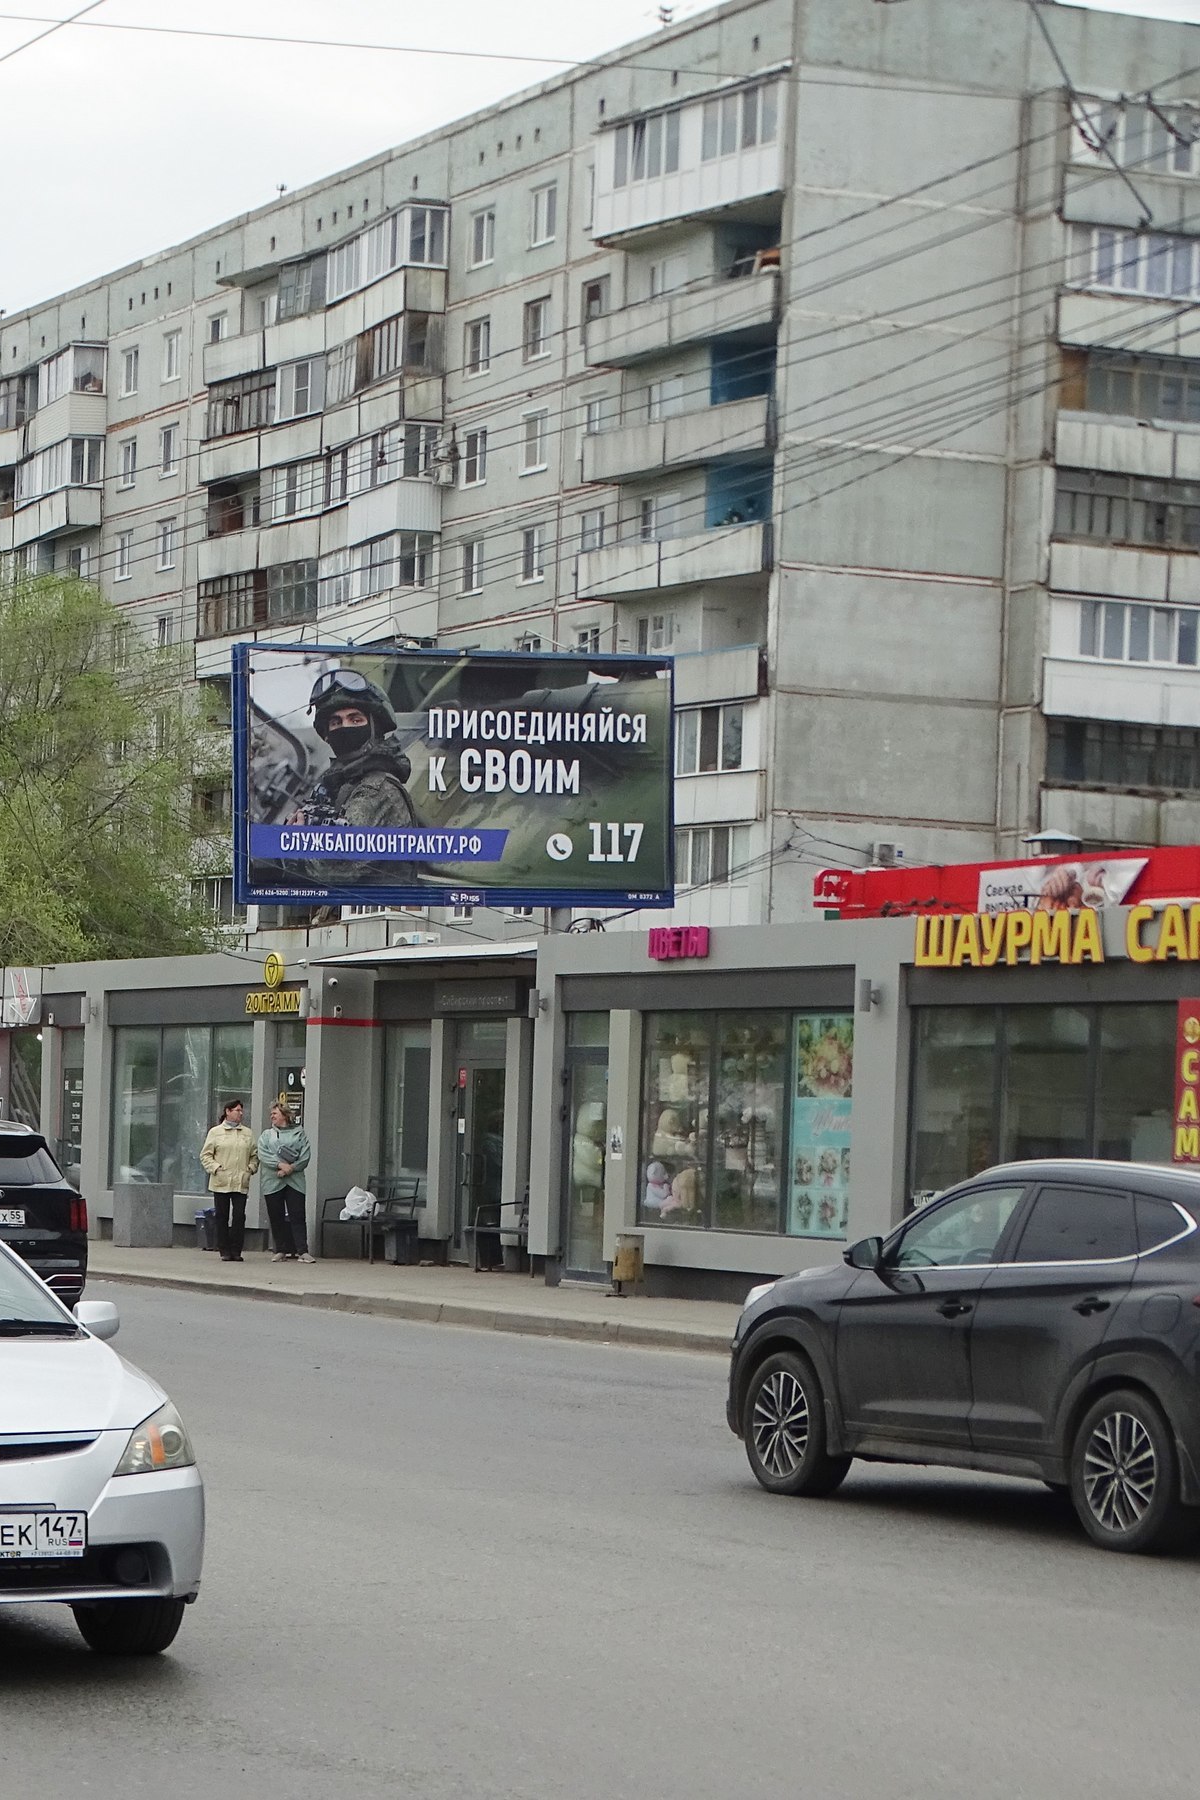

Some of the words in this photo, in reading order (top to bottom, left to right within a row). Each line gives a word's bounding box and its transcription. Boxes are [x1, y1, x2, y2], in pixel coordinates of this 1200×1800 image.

[428, 707, 647, 744] ПРИСОЕДИНЯЙСЯ
[280, 831, 482, 857] СЛУЖБАПОКОНТРАКТУ.РФ
[588, 822, 644, 862] 117
[648, 926, 710, 960] ЦВЕТЫ
[915, 907, 1105, 968] ШАУРМА
[10, 1210, 21, 1220] 55
[39, 1516, 78, 1538] 147
[48, 1538, 68, 1547] RUS
